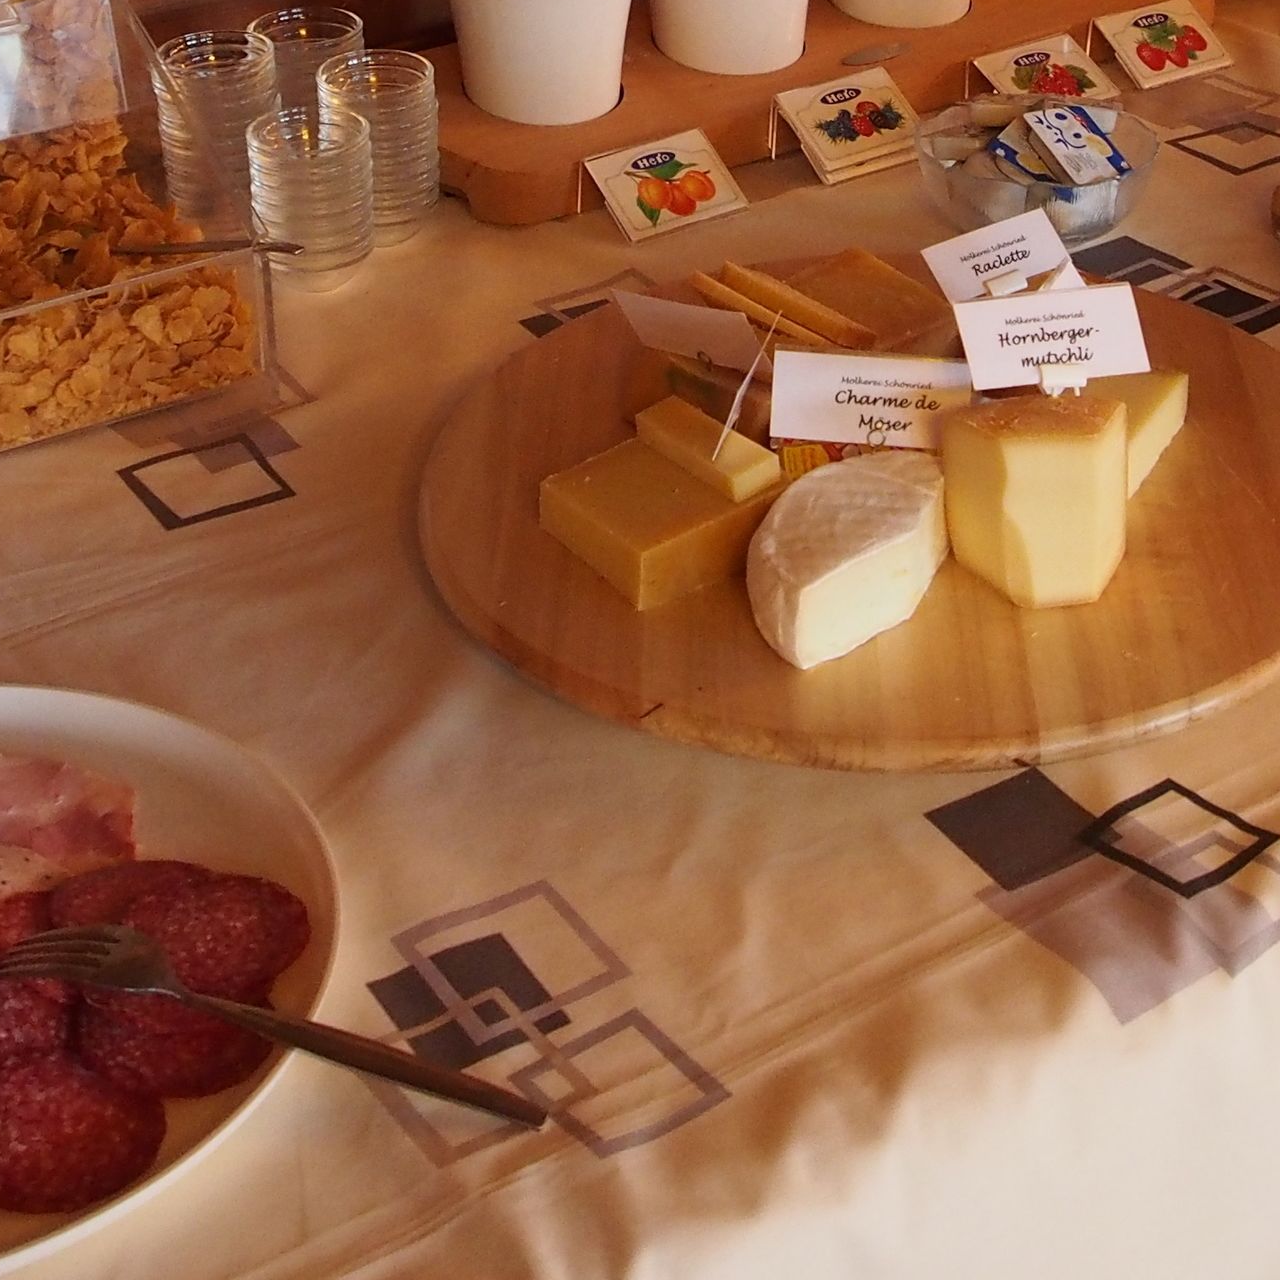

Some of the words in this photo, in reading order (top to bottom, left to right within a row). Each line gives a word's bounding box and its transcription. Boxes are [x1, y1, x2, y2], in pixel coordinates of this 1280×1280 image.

[1137, 13, 1166, 28] Hero
[1018, 52, 1047, 67] Hero
[823, 89, 857, 105] Hero
[637, 151, 670, 170] Hero
[971, 247, 1031, 277] Raclette
[998, 326, 1101, 348] Hornberger-
[1021, 346, 1094, 368] mutschli
[834, 389, 912, 409] Charme
[915, 394, 941, 412] de
